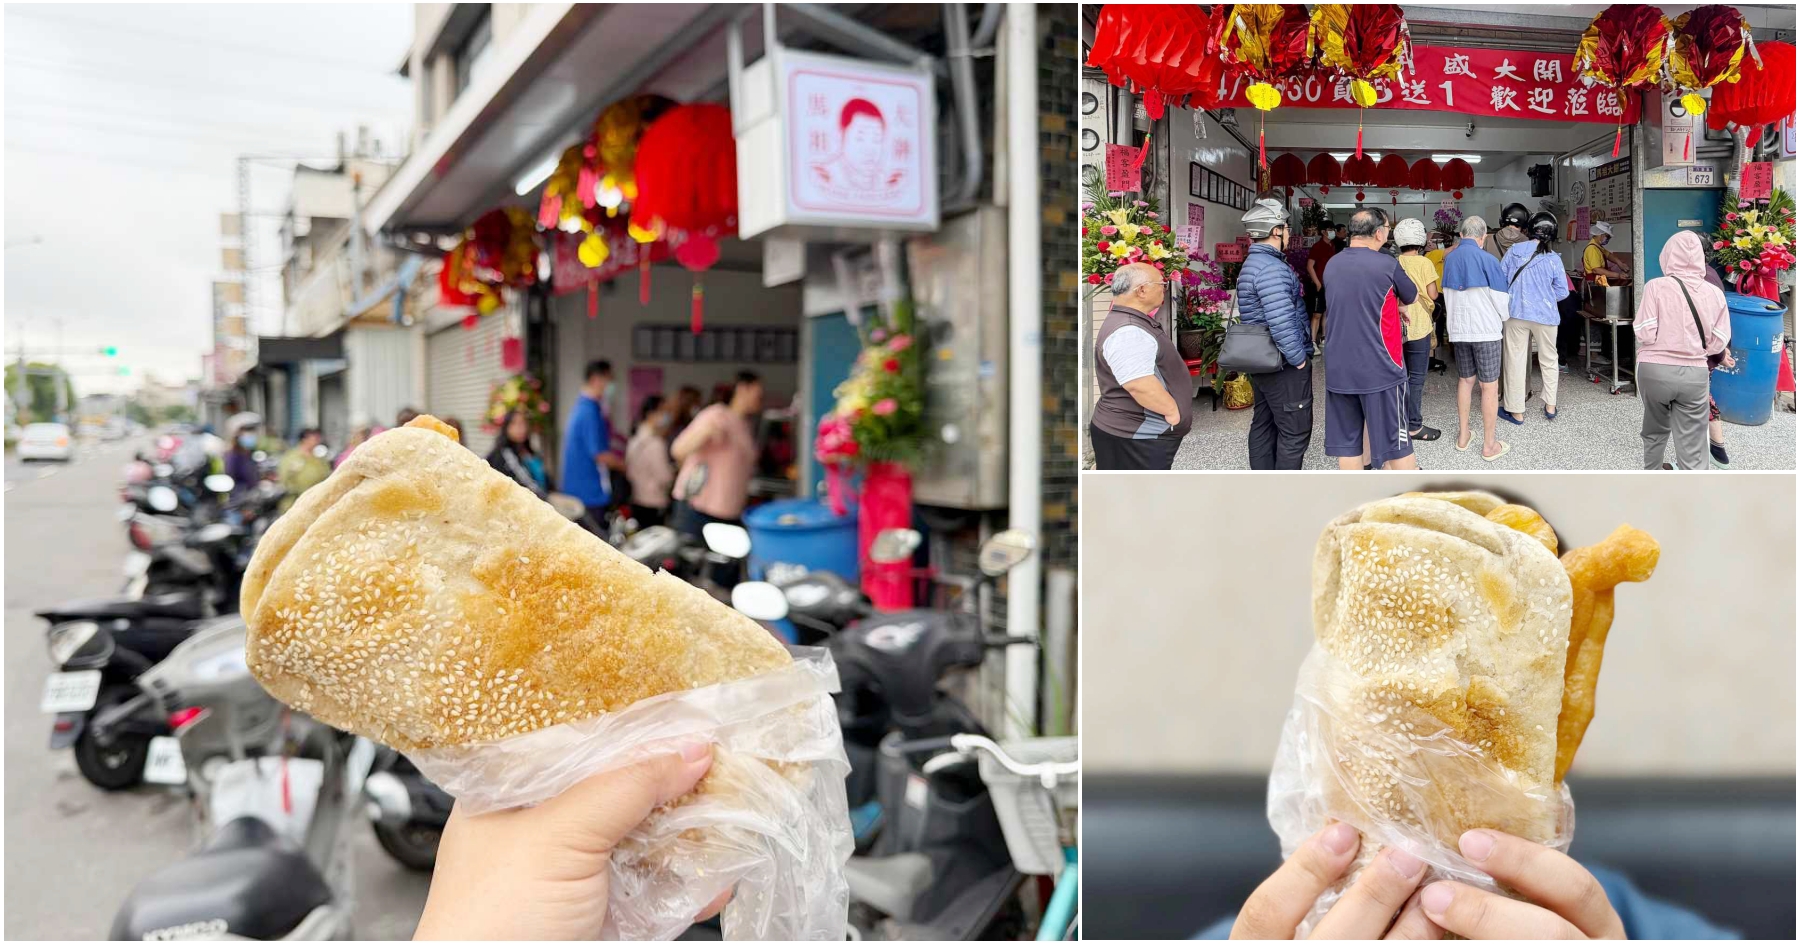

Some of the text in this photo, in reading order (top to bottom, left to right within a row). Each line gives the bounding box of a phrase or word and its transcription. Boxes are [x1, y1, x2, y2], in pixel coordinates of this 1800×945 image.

[1489, 85, 1623, 117] 歡迎蒞臨
[1694, 174, 1710, 184] 673
